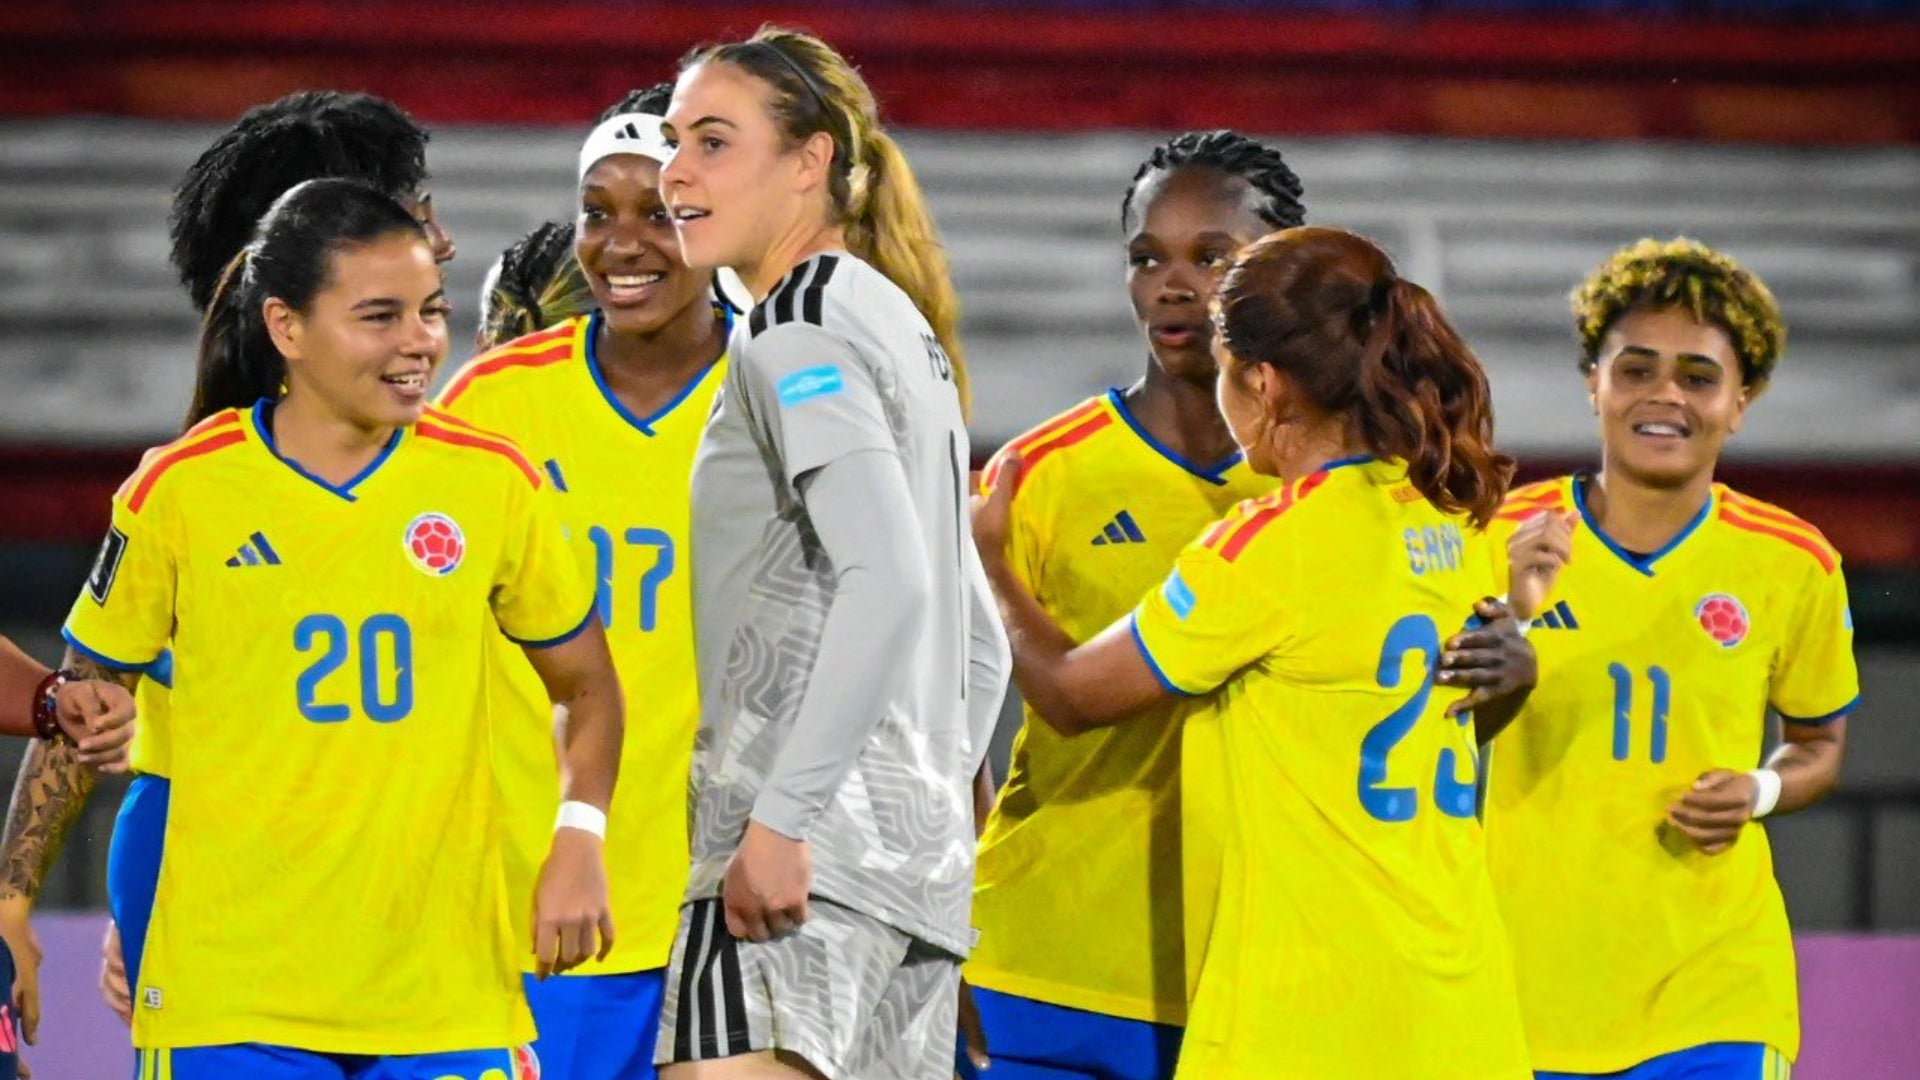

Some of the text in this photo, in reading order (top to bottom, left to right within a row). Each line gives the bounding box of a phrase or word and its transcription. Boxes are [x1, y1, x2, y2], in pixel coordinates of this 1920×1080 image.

[588, 525, 675, 632] 17
[293, 613, 412, 723] 20
[1608, 662, 1670, 764] 11
